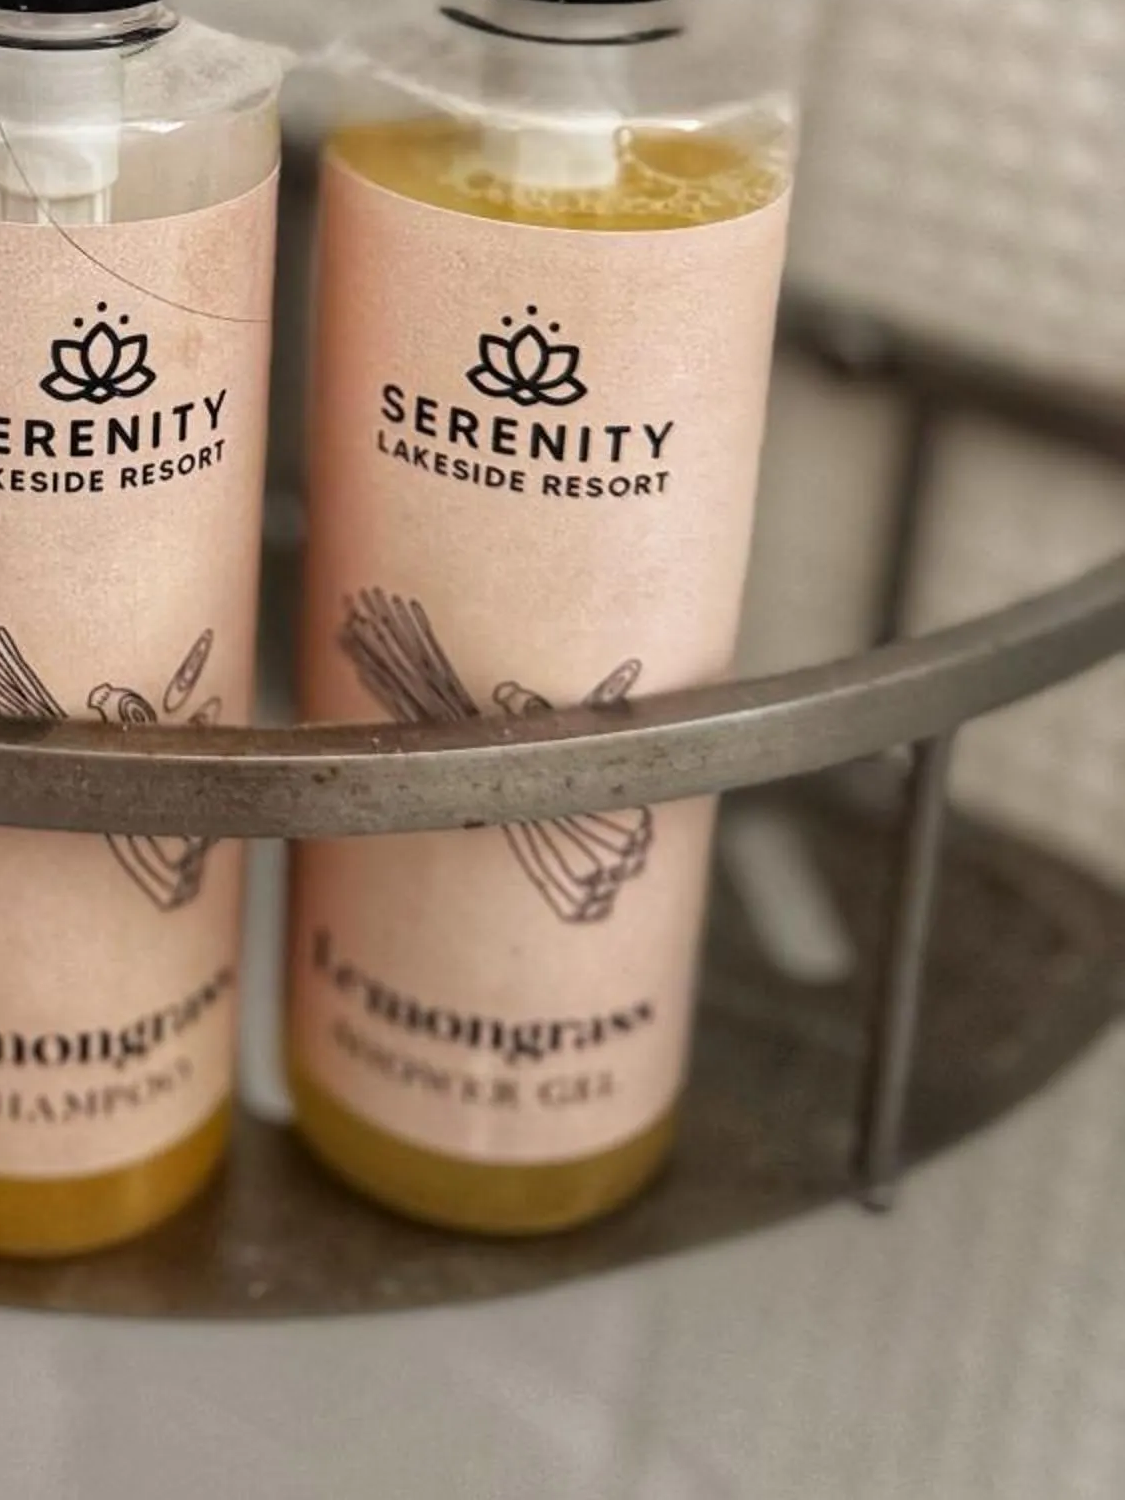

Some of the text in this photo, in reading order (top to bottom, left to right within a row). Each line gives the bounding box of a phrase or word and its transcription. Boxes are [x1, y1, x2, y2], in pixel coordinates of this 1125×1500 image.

[380, 383, 674, 463] SERENITY
[120, 439, 226, 489] RESORT
[377, 429, 671, 498] LAKESIDE RESORT
[311, 925, 656, 1065] Lemongrass
